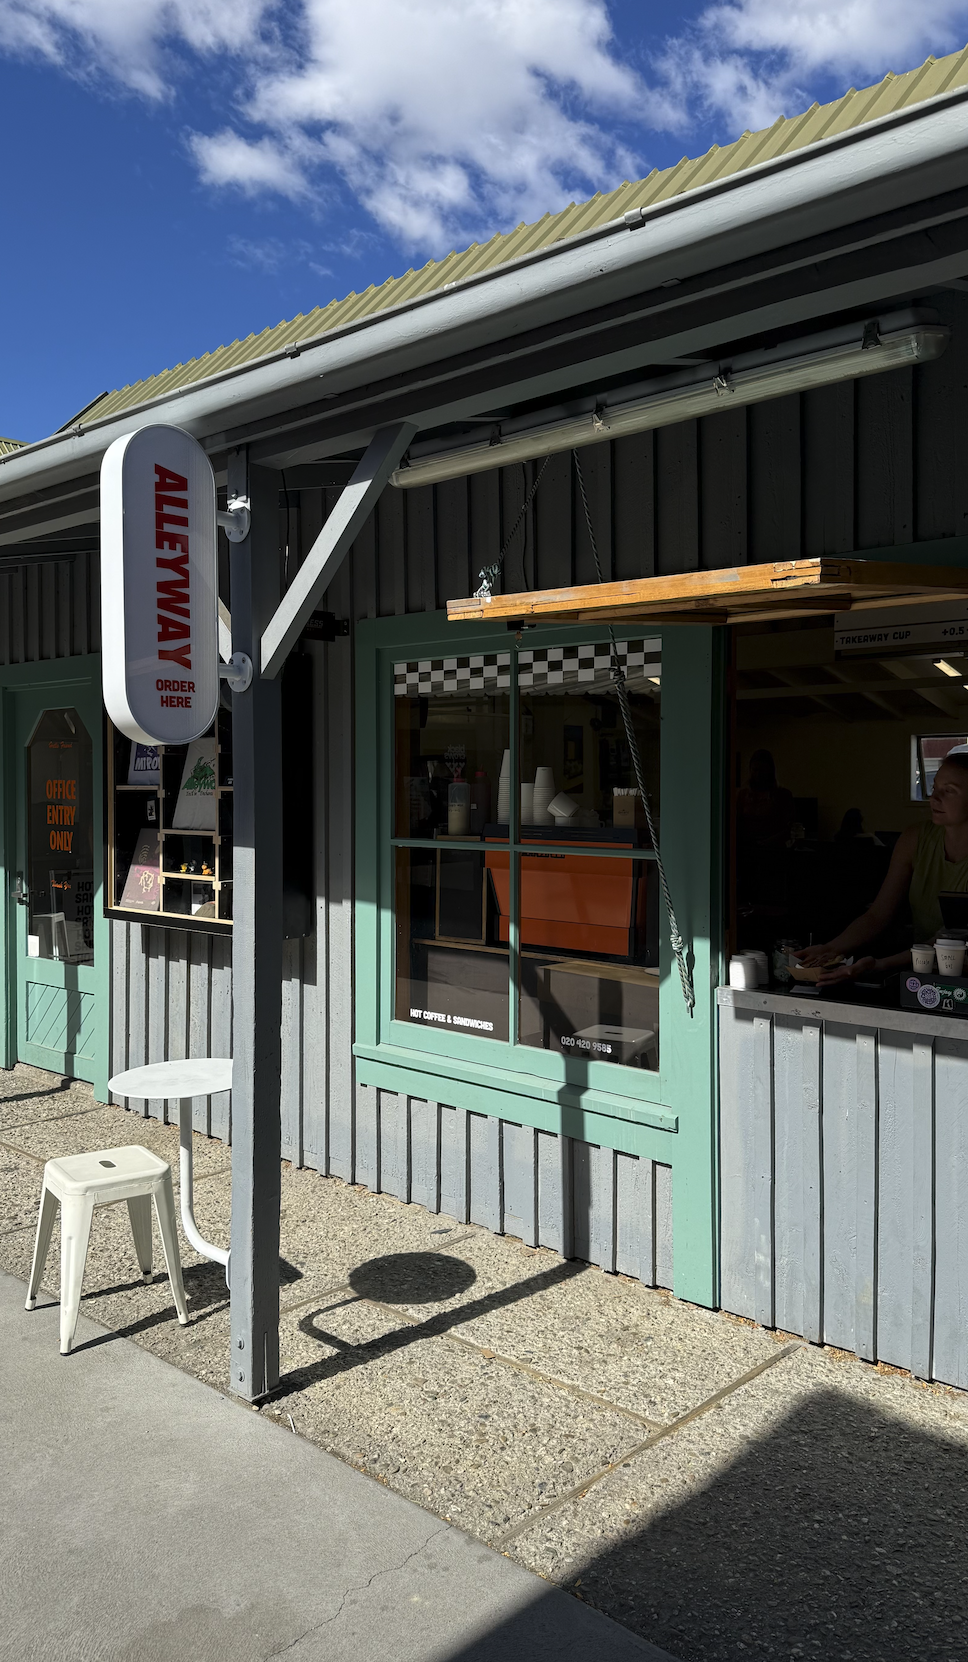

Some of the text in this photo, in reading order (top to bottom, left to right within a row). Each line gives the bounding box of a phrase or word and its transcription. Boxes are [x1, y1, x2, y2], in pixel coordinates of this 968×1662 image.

[154, 463, 192, 670] ALLEYWAY
[839, 627, 965, 645] TAKEAWAY CUP +0.5
[156, 678, 196, 693] ORDER
[160, 695, 192, 708] HERE
[46, 779, 77, 800] OFFICE
[46, 804, 77, 826] ENTRY
[49, 829, 74, 851] ONLY
[77, 880, 94, 892] HO
[409, 1008, 494, 1032] HOT COFFEE & SANDWICHES
[560, 1035, 612, 1054] 020 420 9585
